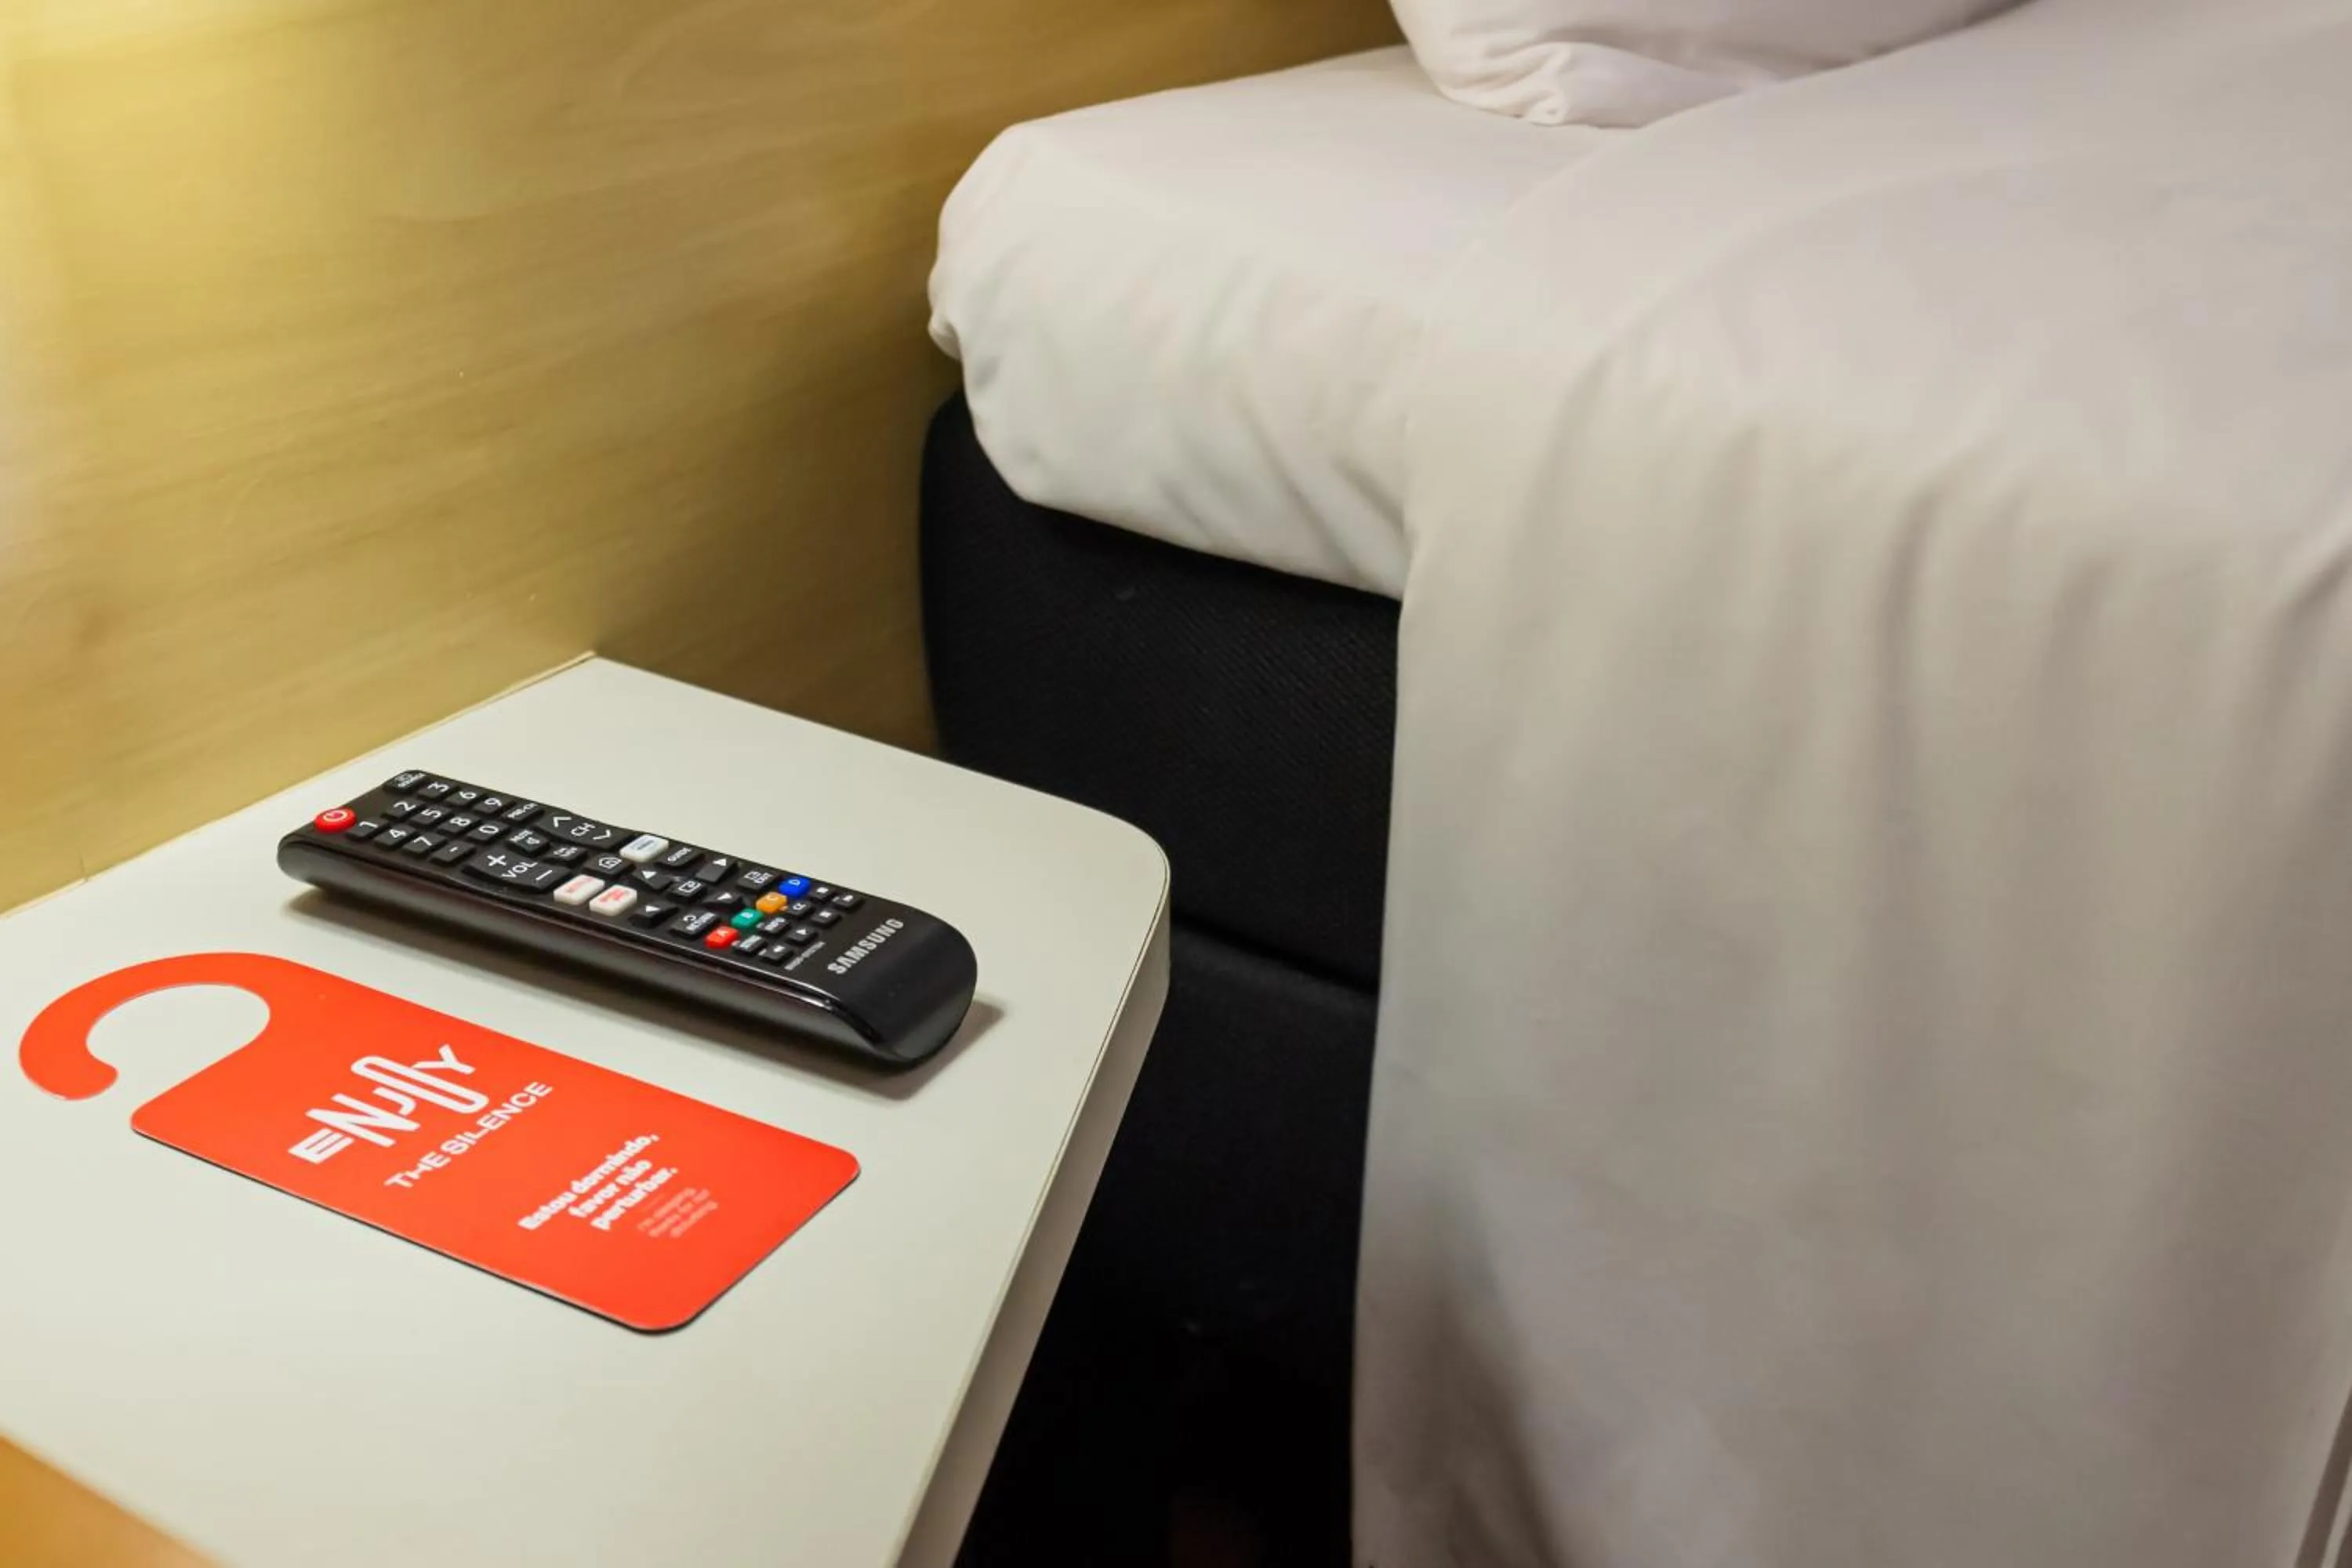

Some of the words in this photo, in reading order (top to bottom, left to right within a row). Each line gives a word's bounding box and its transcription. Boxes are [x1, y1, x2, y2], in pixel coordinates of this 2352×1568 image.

[427, 781, 449, 793] 3
[459, 790, 477, 800] 6
[394, 800, 416, 811] 2
[485, 797, 502, 807] 9
[421, 808, 442, 819] 5
[449, 816, 470, 827] 8
[389, 828, 408, 840] 4
[478, 825, 499, 835] 0
[571, 822, 596, 837] CH
[413, 835, 432, 847] 7
[501, 862, 539, 879] VOL
[827, 917, 905, 975] SAMSUNG
[288, 1044, 490, 1165] ENJOY
[383, 1151, 452, 1189] THE
[440, 1080, 554, 1156] SILENCE
[517, 1191, 578, 1231] Estou
[571, 1134, 660, 1195] dormindo,
[568, 1182, 620, 1218] favor
[615, 1160, 652, 1185] não
[590, 1167, 678, 1232] perturbar.
